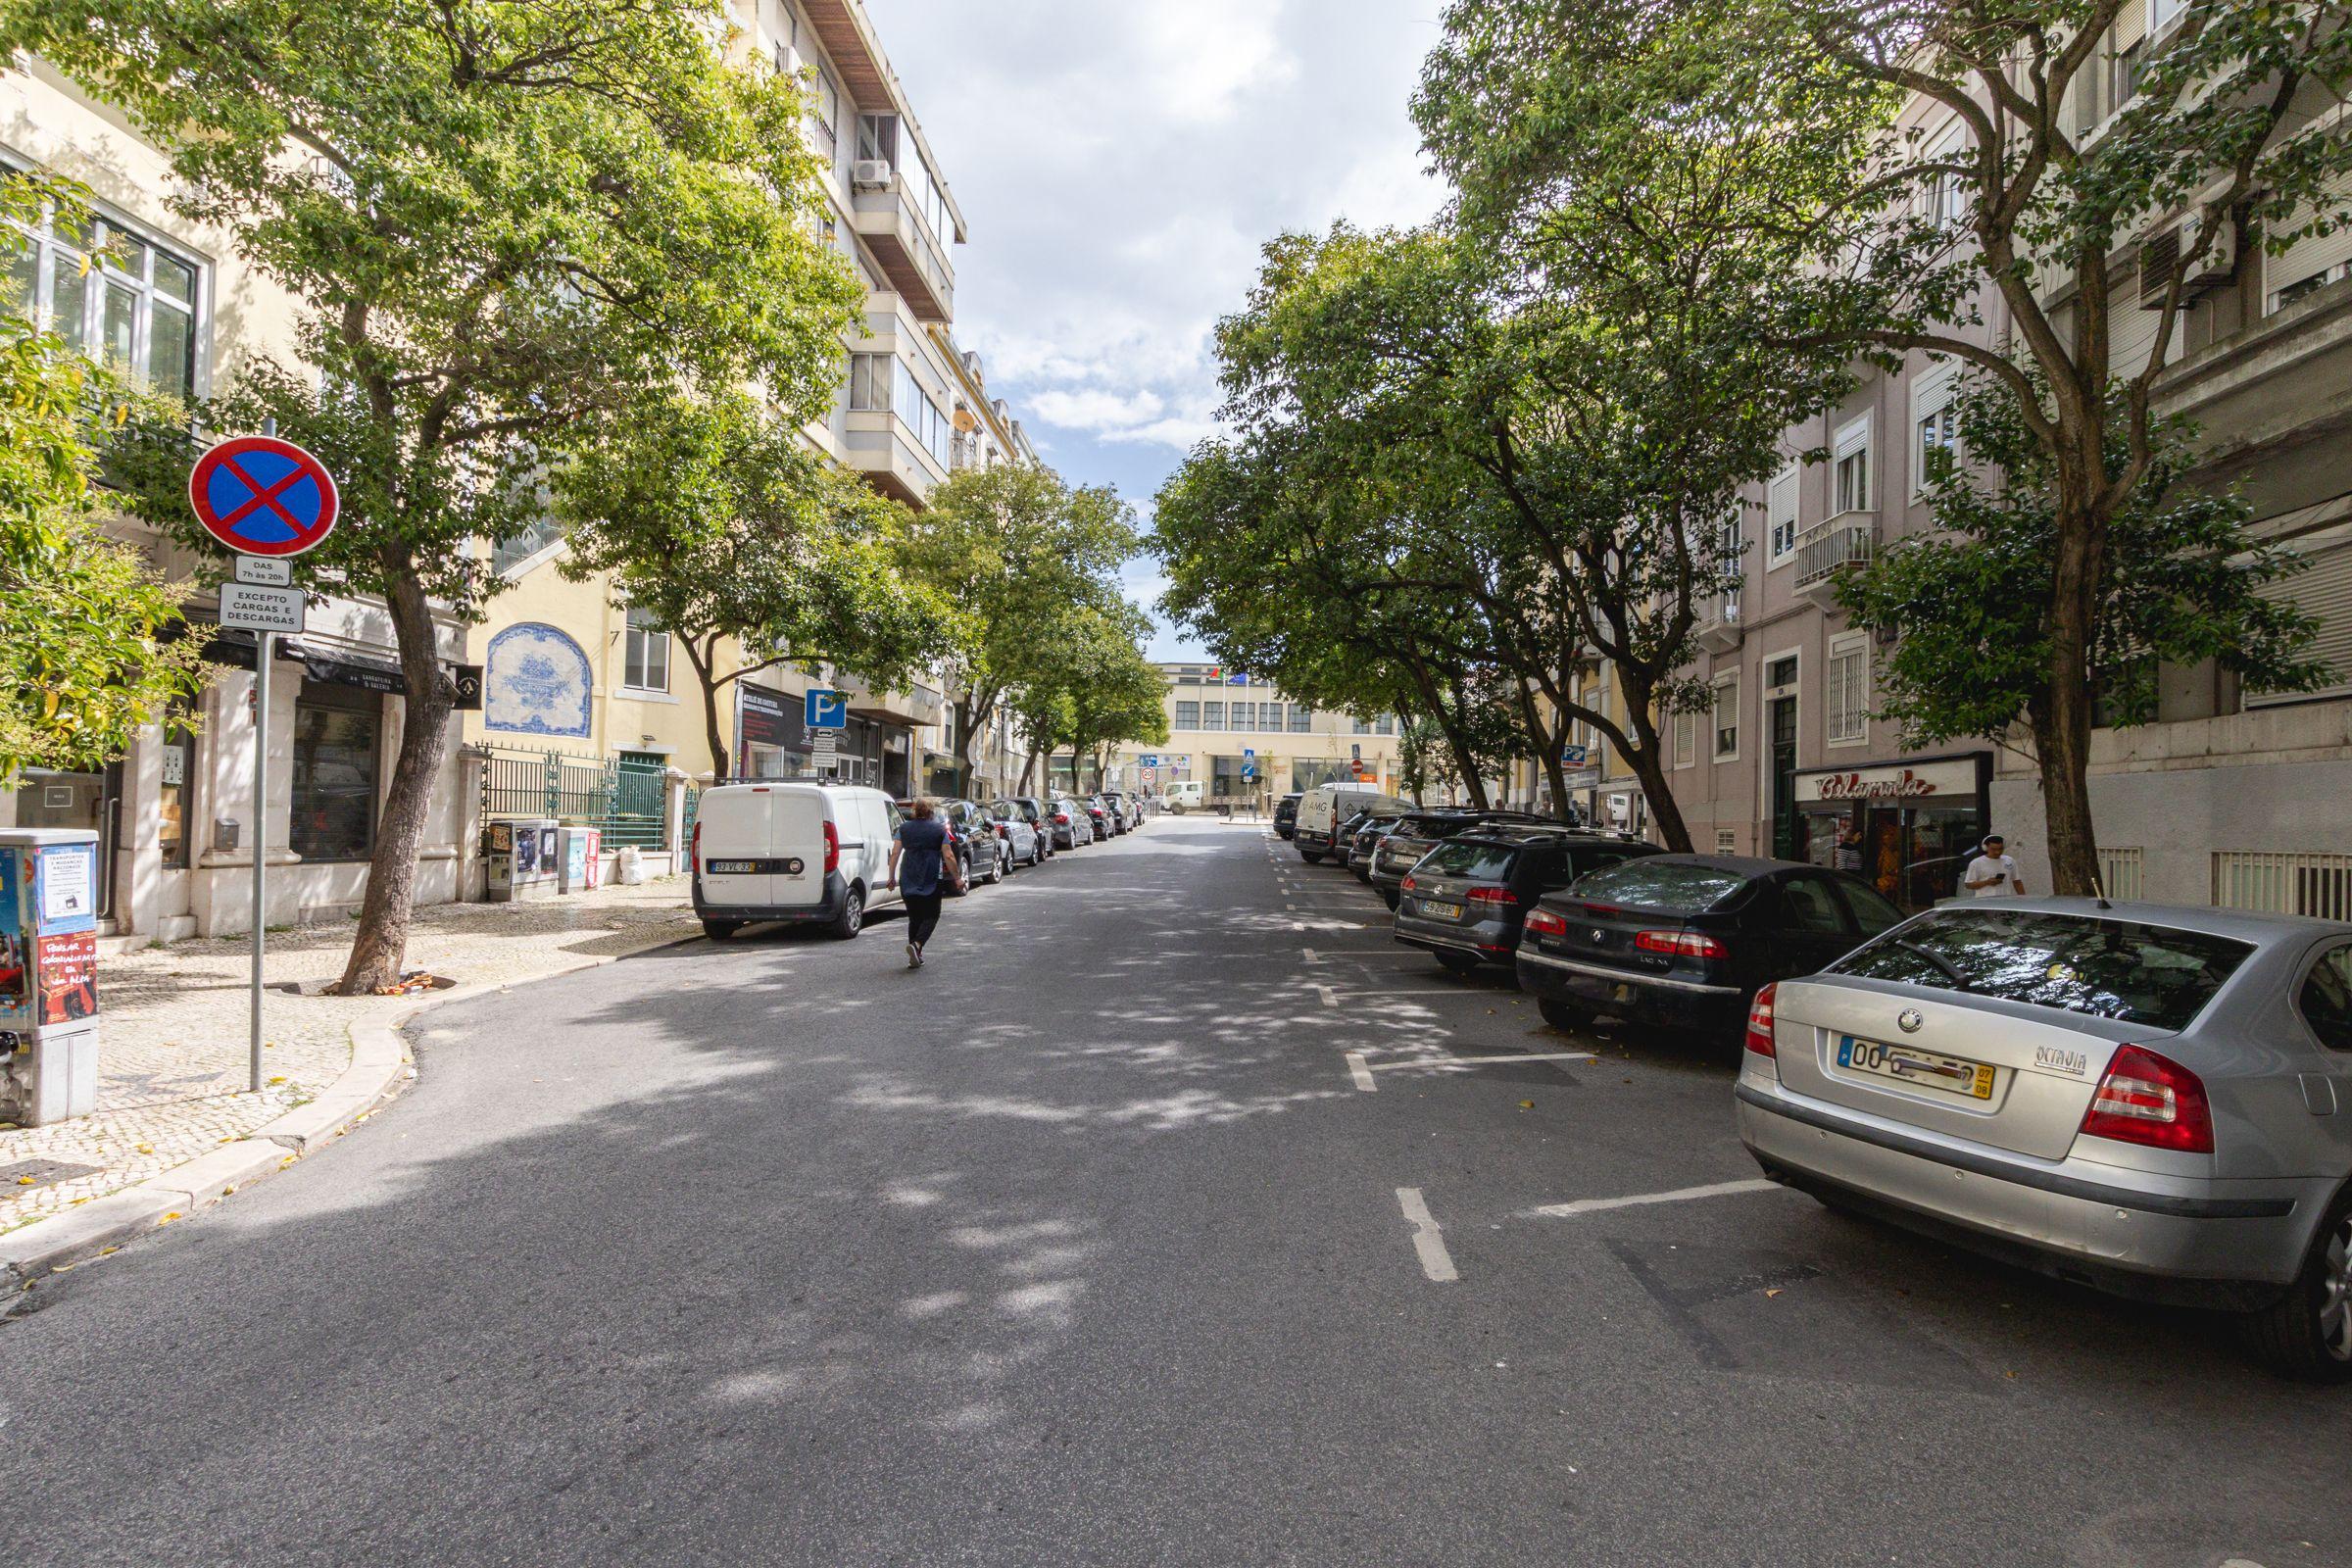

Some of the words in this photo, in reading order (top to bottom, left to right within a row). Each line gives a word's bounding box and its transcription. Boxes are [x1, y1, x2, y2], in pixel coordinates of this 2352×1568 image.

[253, 562, 273, 570] DAS
[237, 591, 287, 604] EXCEPTO
[233, 602, 278, 613] CARGAS
[227, 612, 295, 625] DESCARGAS
[814, 694, 837, 723] P
[1564, 746, 1573, 758] P
[1309, 802, 1327, 812] AMG
[2036, 1045, 2086, 1070] OCTAVIA
[1978, 1068, 1990, 1079] 07
[1976, 1084, 1987, 1096] 08
